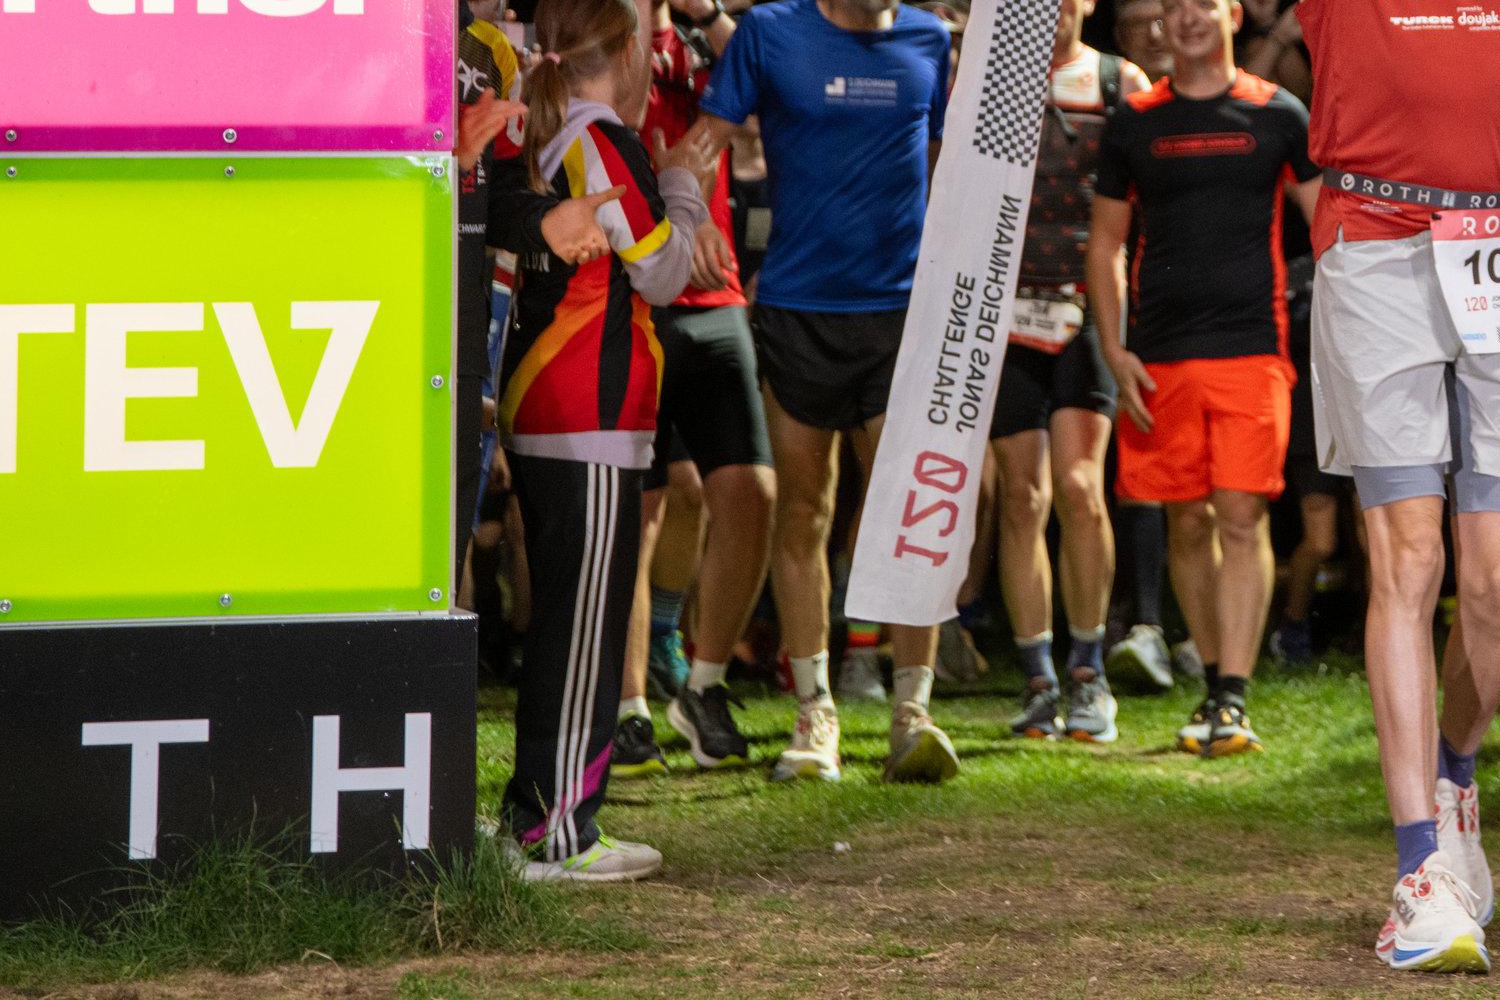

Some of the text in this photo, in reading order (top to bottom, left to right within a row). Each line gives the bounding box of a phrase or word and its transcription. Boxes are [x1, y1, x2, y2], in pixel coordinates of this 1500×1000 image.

[1390, 16, 1454, 25] TURCK
[1362, 179, 1431, 203] ROTH
[1464, 296, 1488, 312] 120
